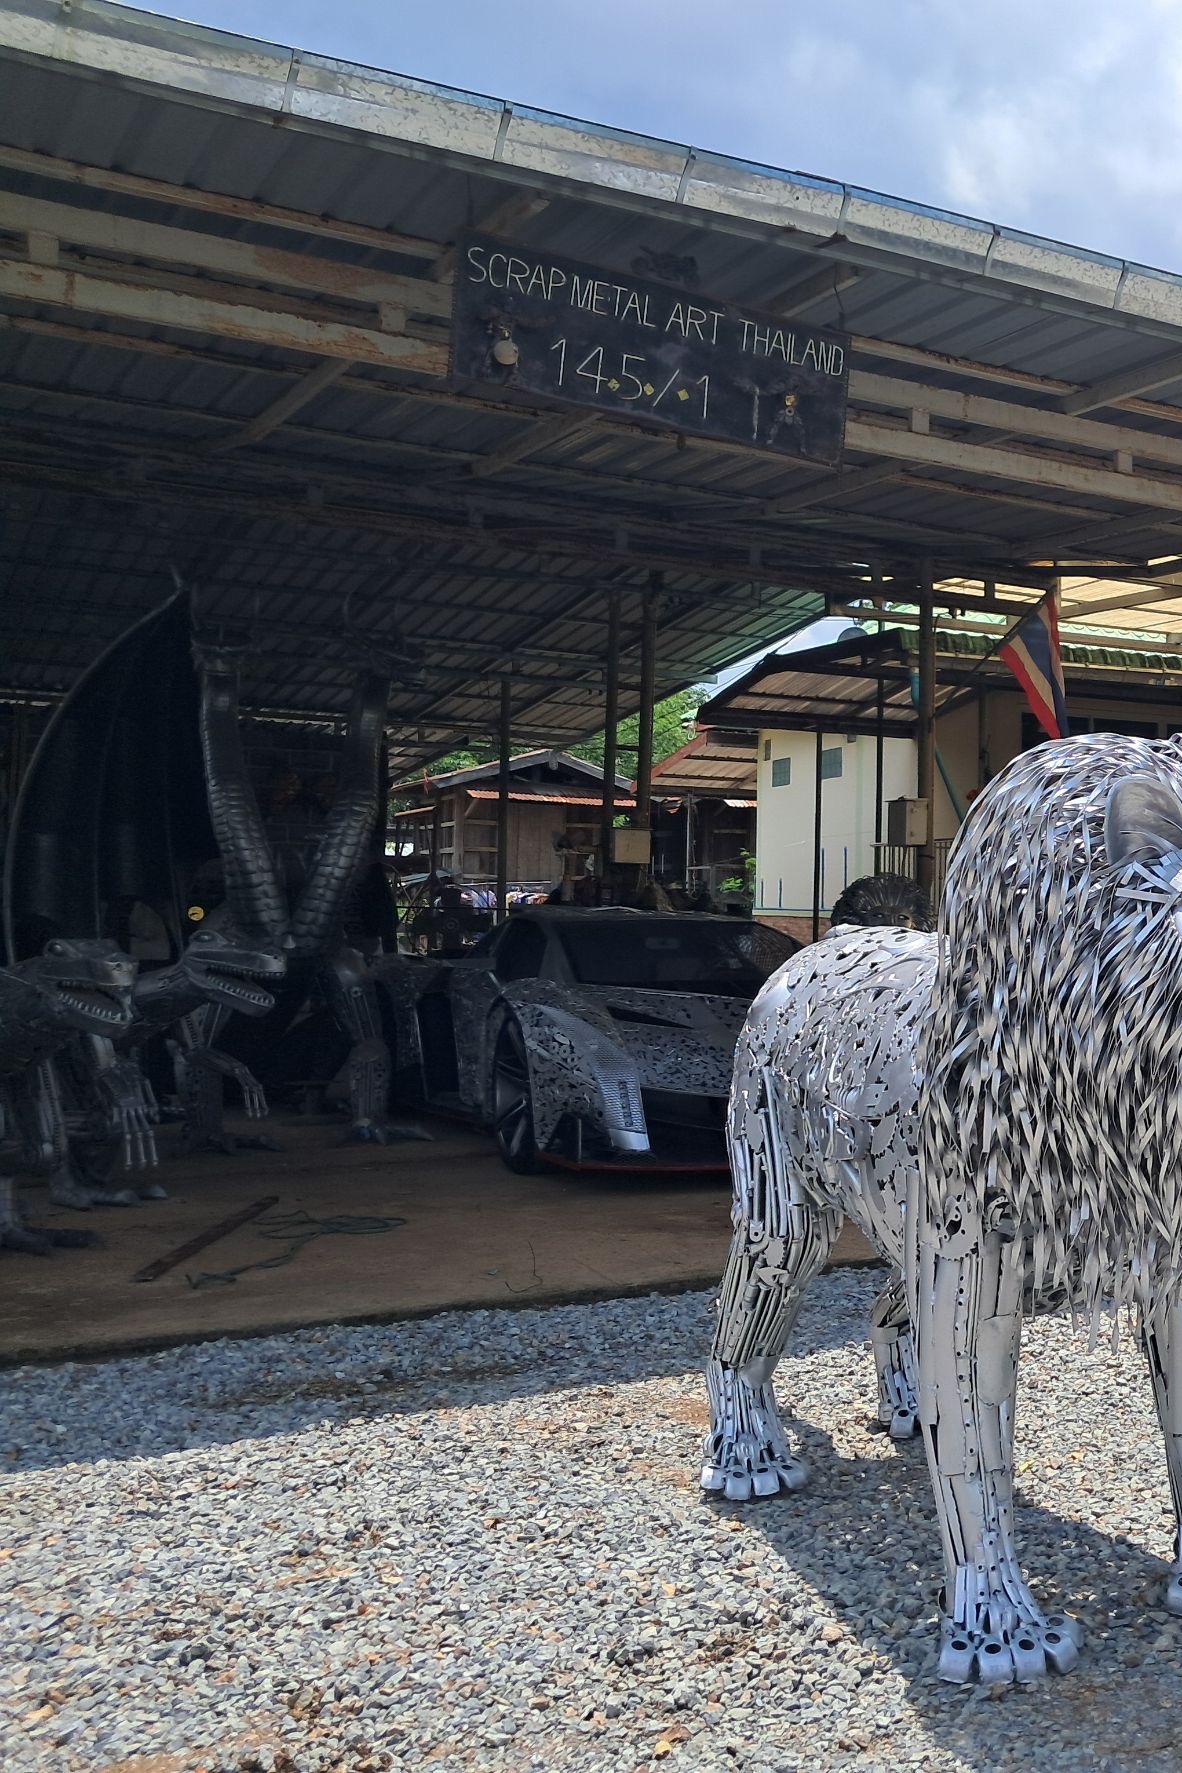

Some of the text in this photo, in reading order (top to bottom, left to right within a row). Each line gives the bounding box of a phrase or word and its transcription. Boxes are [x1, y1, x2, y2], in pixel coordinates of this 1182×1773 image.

[467, 246, 844, 377] SCRAP METAL ART THAILAND
